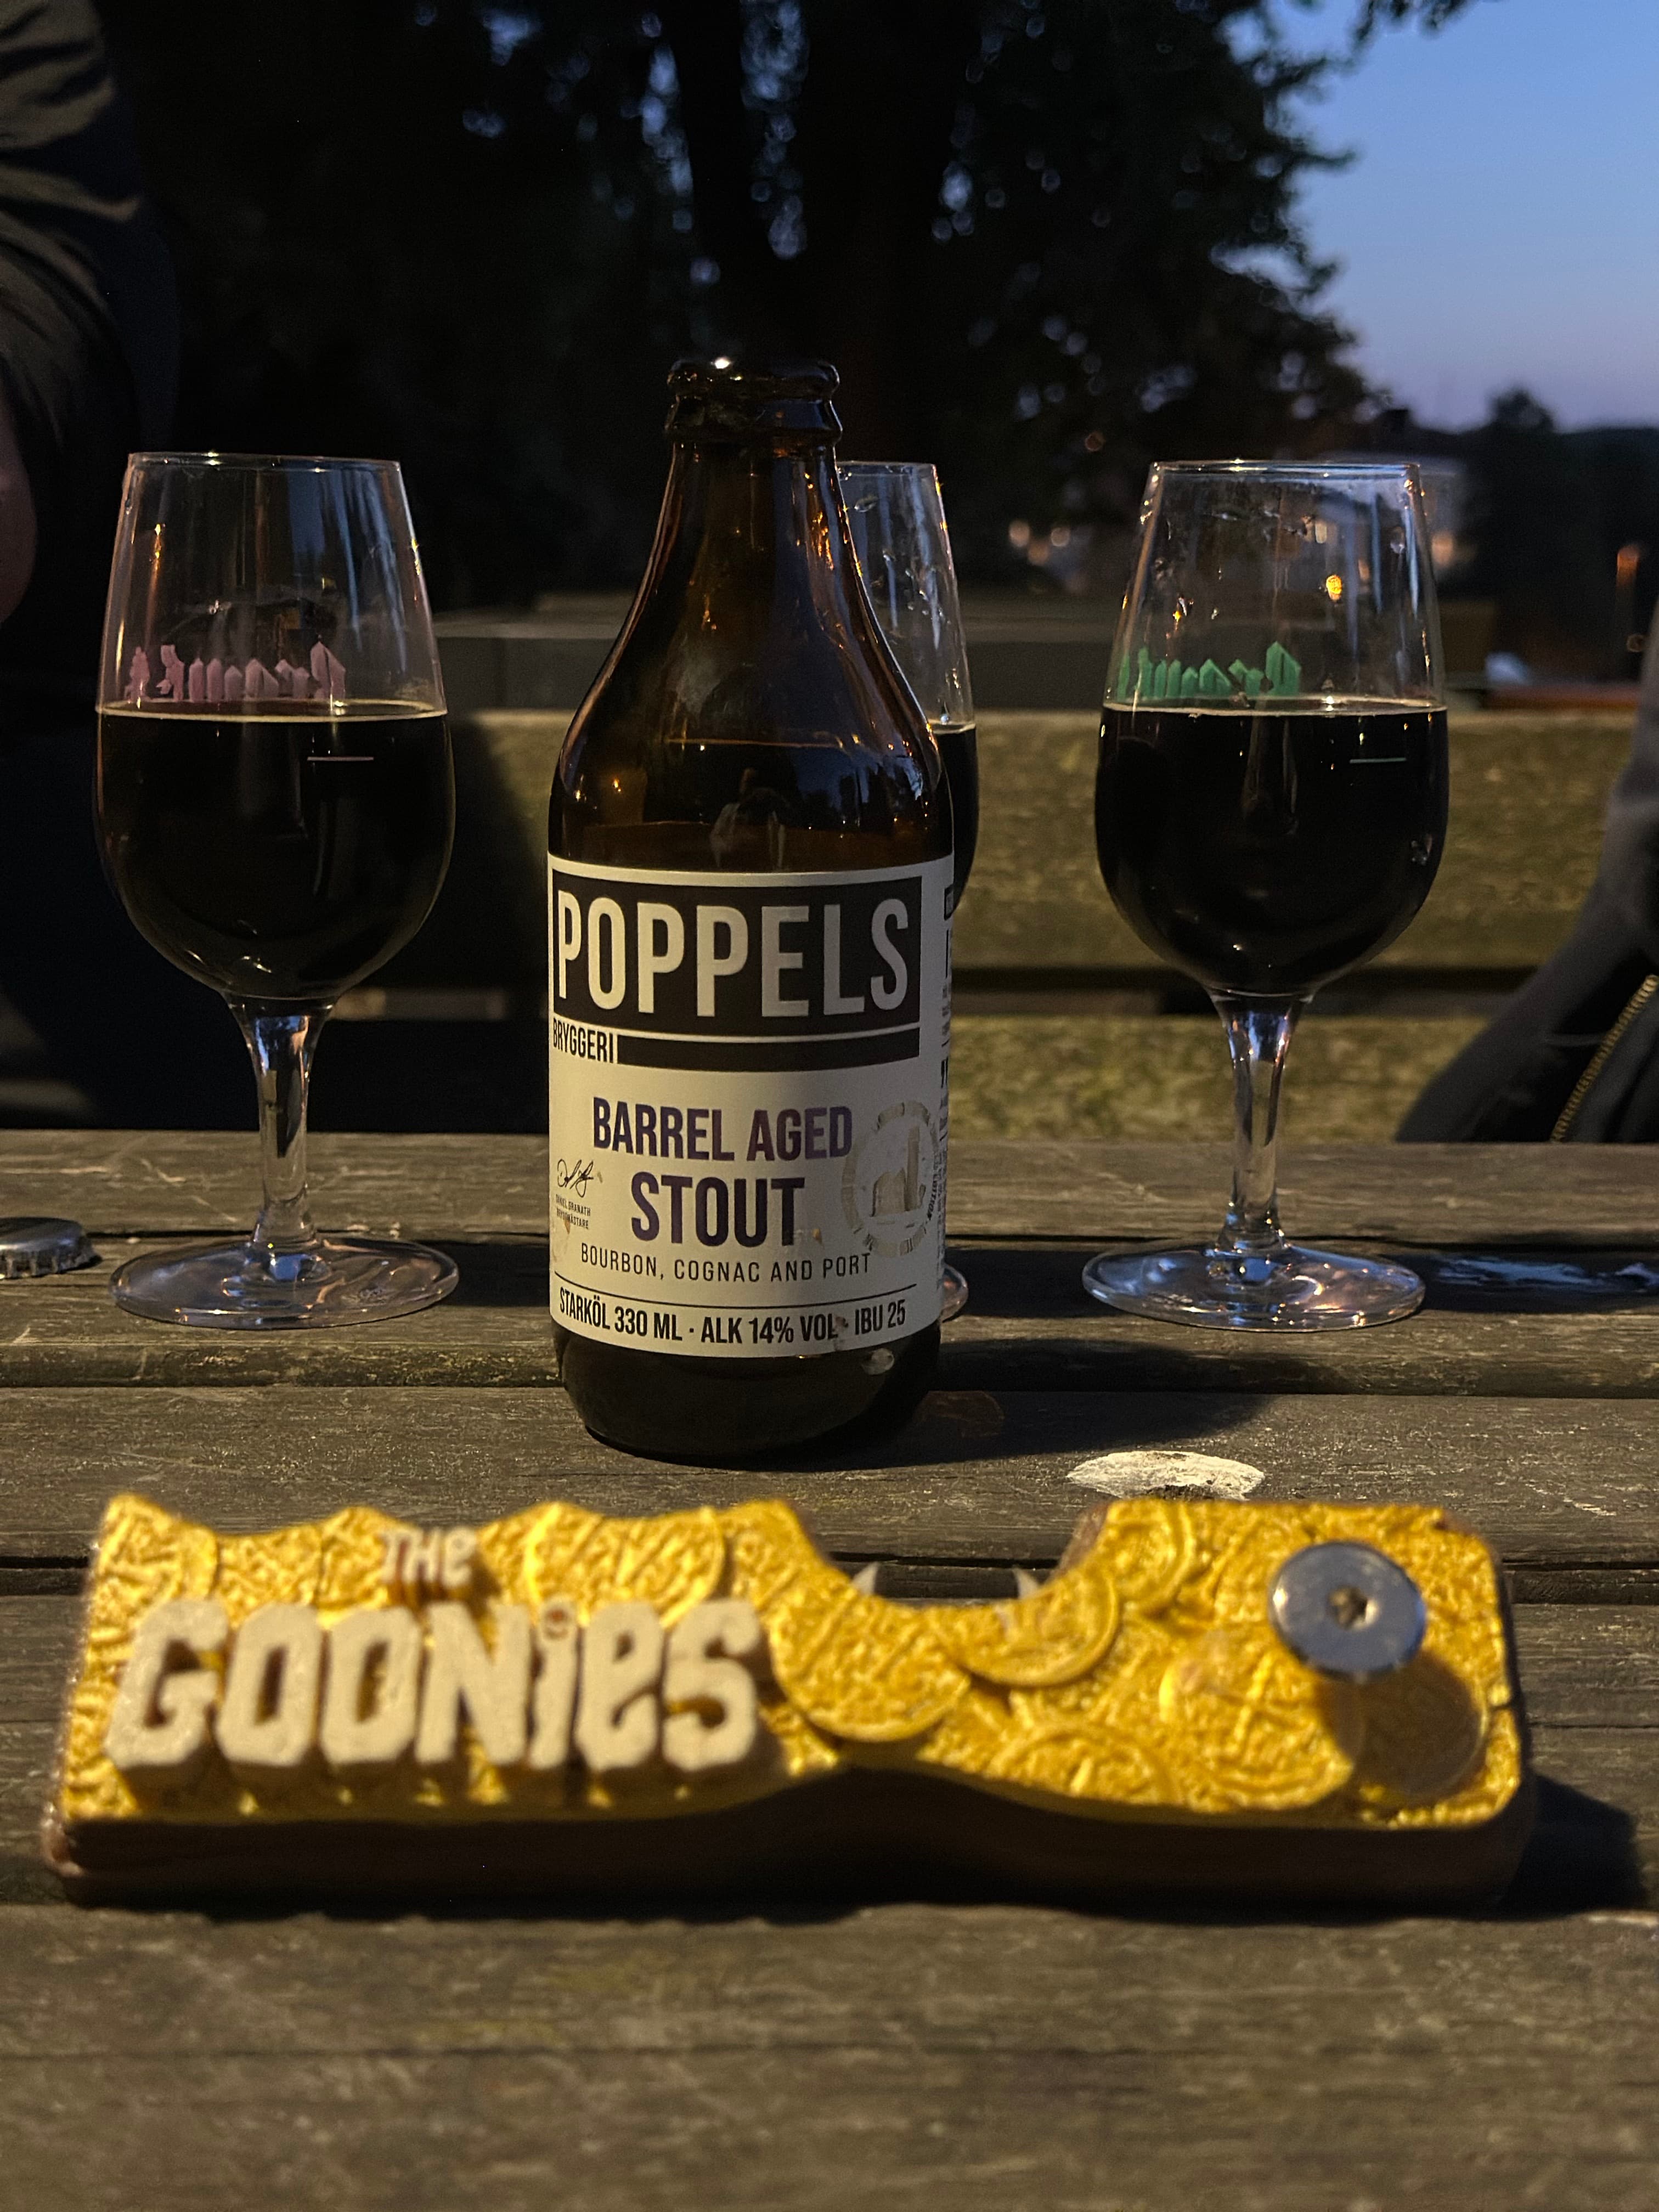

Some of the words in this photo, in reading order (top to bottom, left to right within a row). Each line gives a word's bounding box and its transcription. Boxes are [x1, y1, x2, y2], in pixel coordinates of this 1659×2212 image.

[558, 890, 909, 1017] POPPELS
[554, 1017, 614, 1063] BRYGGERI
[593, 1097, 735, 1160] BARREL
[747, 1105, 853, 1161] AGED
[631, 1172, 805, 1247] STOUT
[582, 1243, 664, 1280] BOURBON,
[674, 1259, 759, 1282] COGNAC
[771, 1260, 812, 1282] AND
[823, 1252, 871, 1279] PORT
[560, 1286, 611, 1330] STARKÖL
[614, 1306, 647, 1337] 330
[653, 1312, 682, 1341] ML
[701, 1317, 742, 1344] ALK
[748, 1317, 794, 1344] 14%
[800, 1313, 838, 1342] VOL
[855, 1305, 883, 1336] IBU
[887, 1299, 906, 1329] 25
